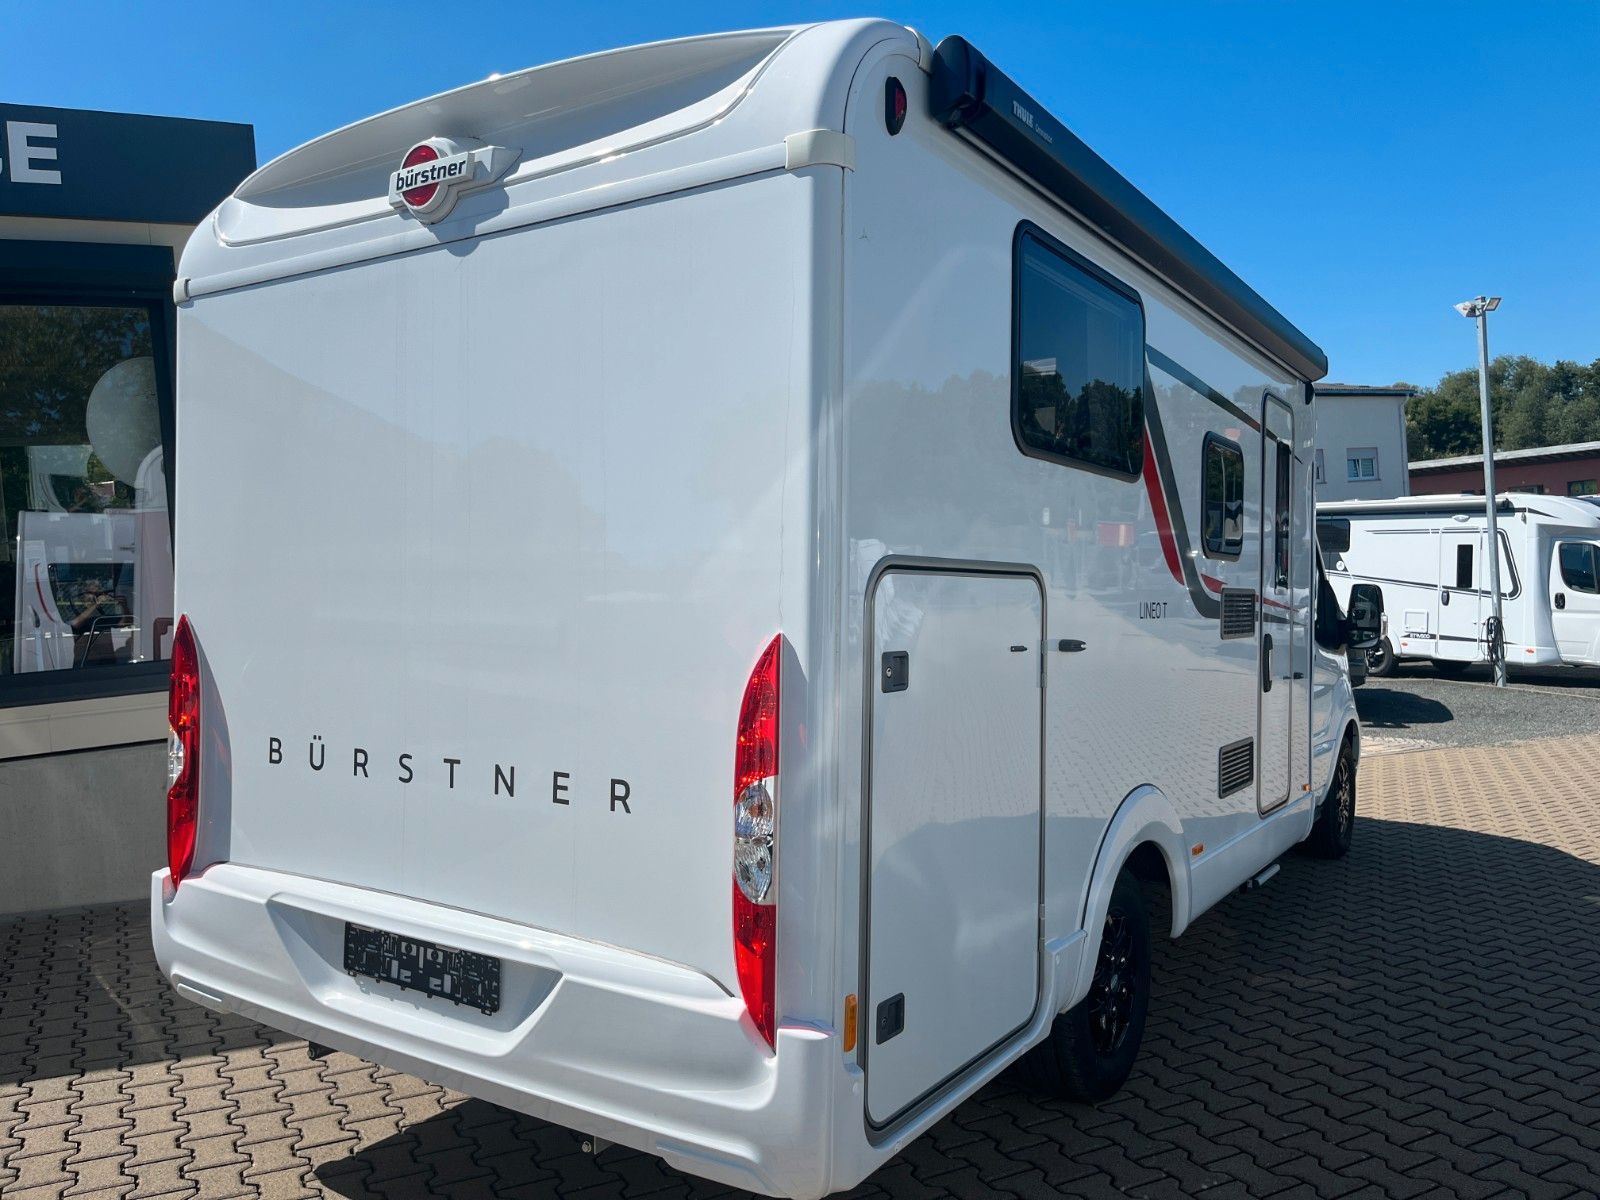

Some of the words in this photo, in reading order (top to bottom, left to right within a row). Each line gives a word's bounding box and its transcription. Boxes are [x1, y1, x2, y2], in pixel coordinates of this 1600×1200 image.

[1012, 100, 1034, 128] THULE
[0, 120, 62, 185] E
[395, 159, 467, 192] bürstner
[1139, 601, 1162, 620] LINEO
[268, 734, 632, 815] BÜRSTNER
